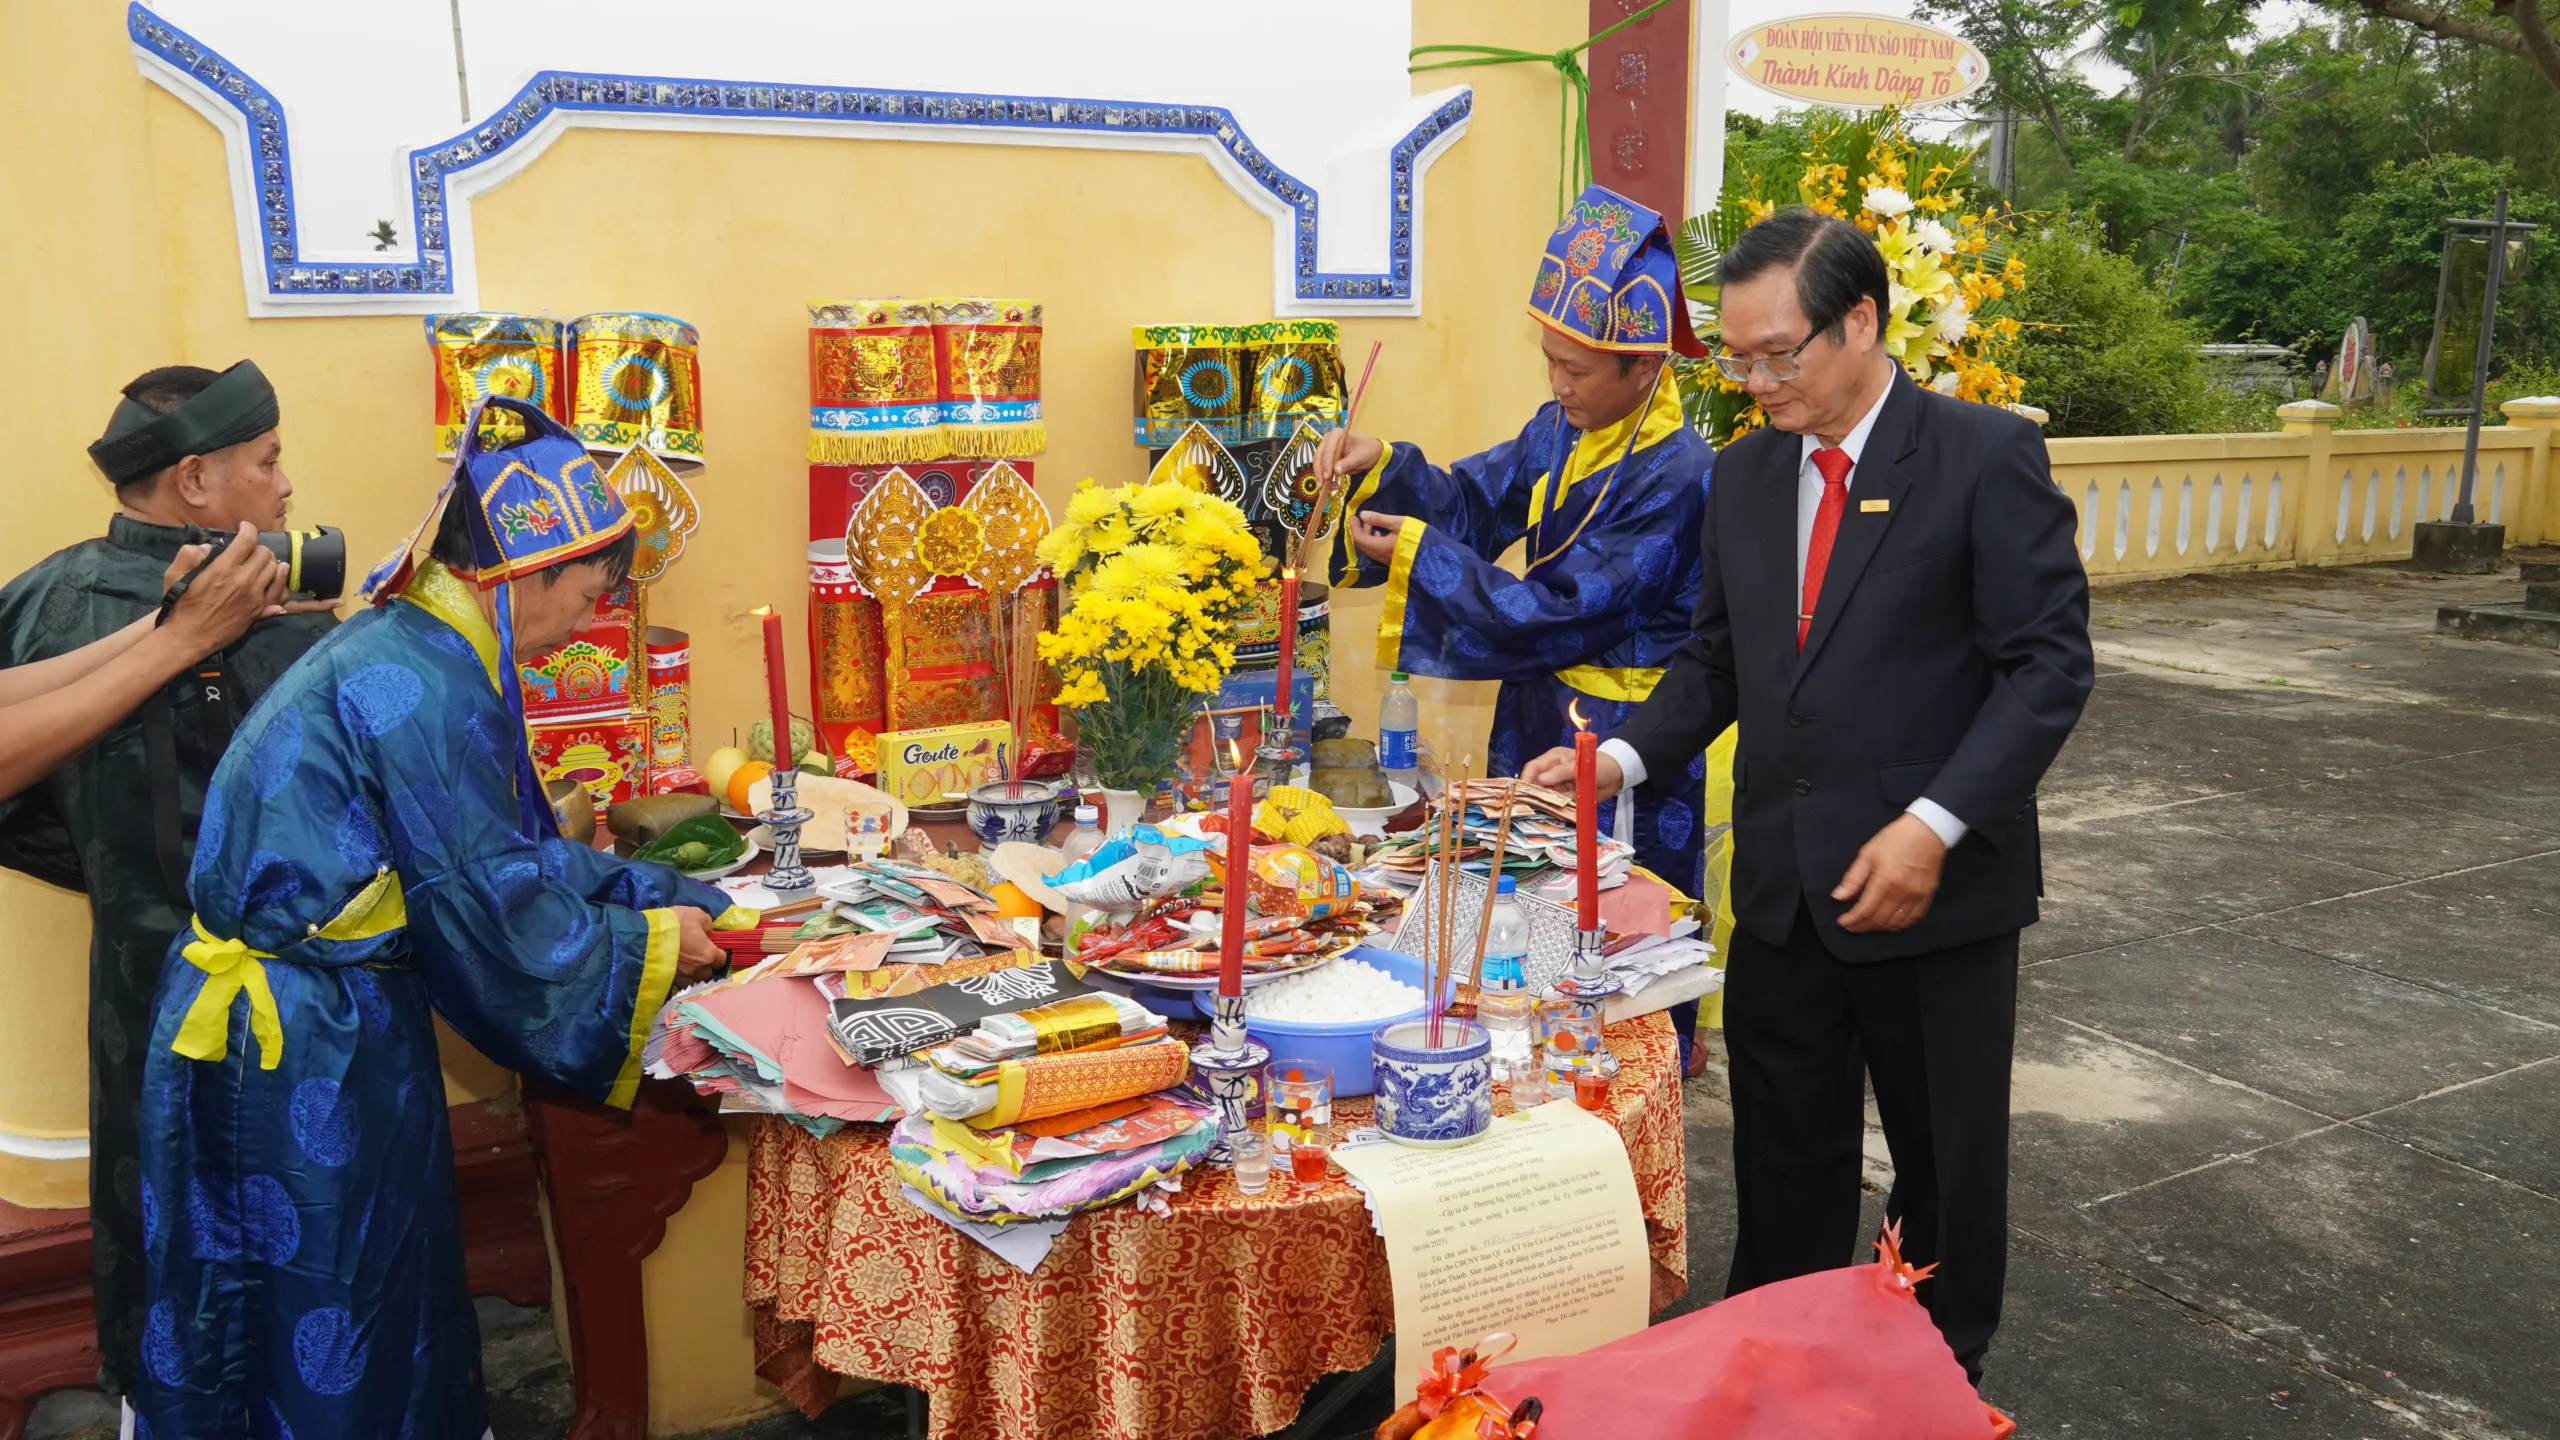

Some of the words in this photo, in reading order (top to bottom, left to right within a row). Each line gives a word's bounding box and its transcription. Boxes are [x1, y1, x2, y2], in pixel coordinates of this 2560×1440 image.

[1766, 24, 1798, 49] ĐOÀN
[1800, 26, 1823, 56] HỘI
[1825, 28, 1852, 52] VIÊN
[1854, 23, 1878, 54] YẾN
[1879, 30, 1900, 56] SÀO
[1902, 33, 1928, 64] VIỆT
[1929, 39, 1955, 60] NAM
[1762, 59, 1819, 87] Thành
[1825, 64, 1869, 90] Kính
[1874, 67, 1925, 98] Dâng
[1930, 67, 1955, 96] Tổ
[903, 743, 959, 764] Gouté
